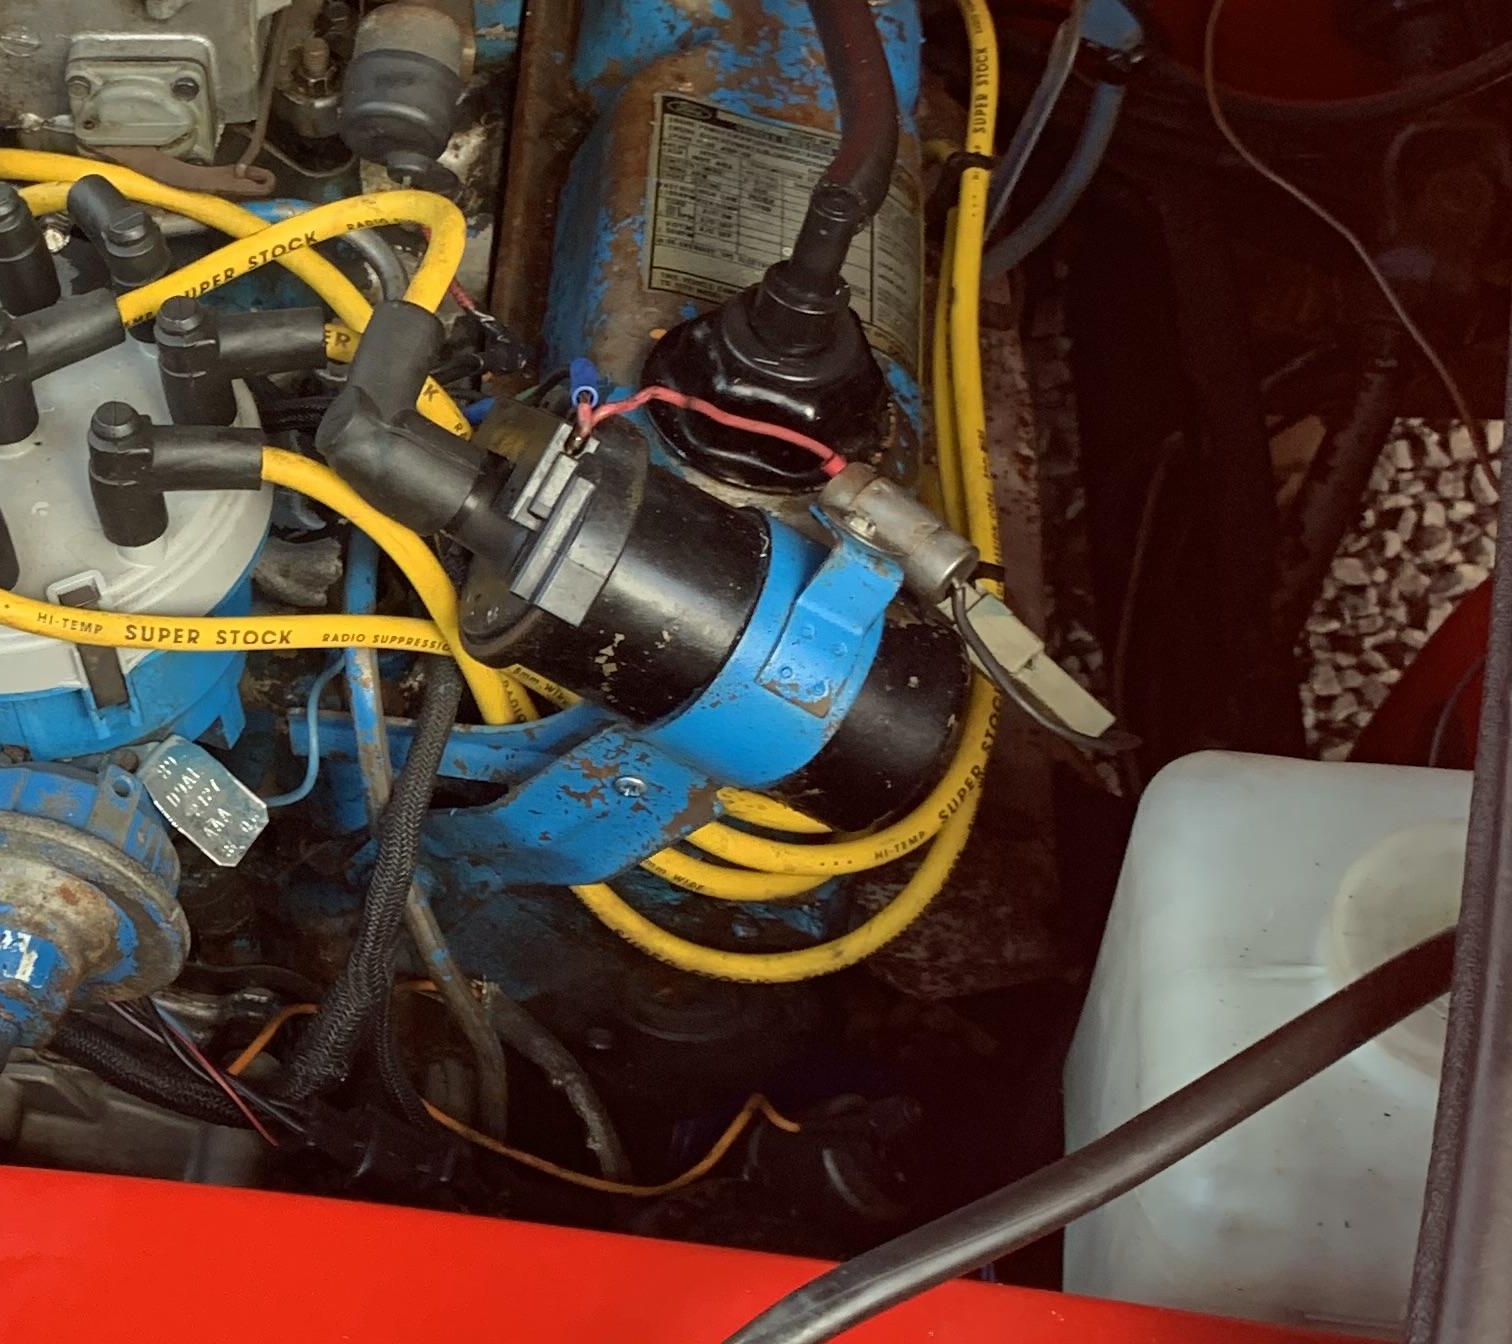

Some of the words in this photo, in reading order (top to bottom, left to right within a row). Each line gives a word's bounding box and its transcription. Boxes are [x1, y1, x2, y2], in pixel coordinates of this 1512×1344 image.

[975, 47, 989, 86] STOCK
[185, 267, 236, 299] UPER
[248, 231, 318, 270] STOCK
[37, 612, 104, 634] HI-TEMP
[125, 624, 201, 645] SUPER
[216, 629, 293, 645] STOCK
[322, 633, 366, 643] RADIO
[372, 634, 451, 652] SUPPRESSIO
[874, 830, 927, 861] HI-TEMP
[938, 764, 985, 825] SUPER
[981, 687, 1002, 752] STOC
